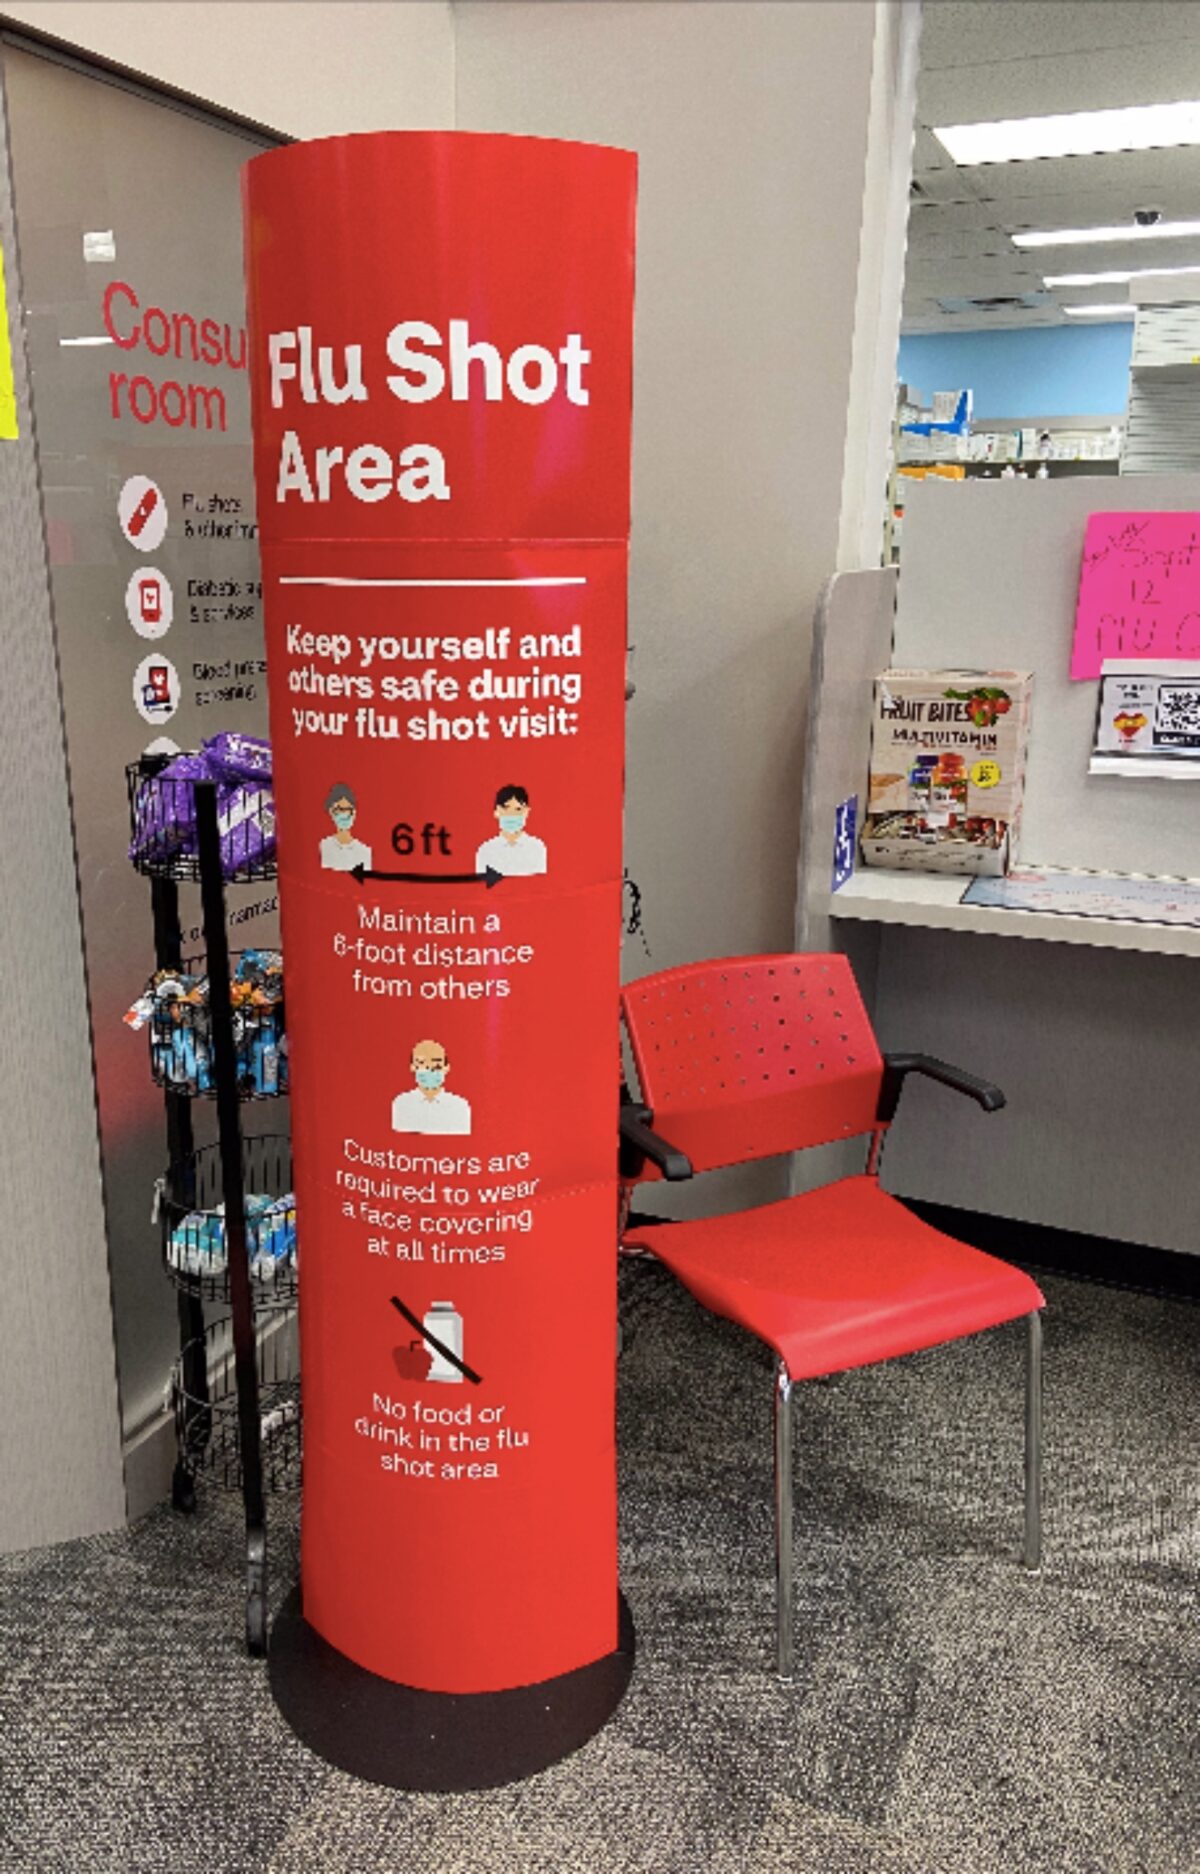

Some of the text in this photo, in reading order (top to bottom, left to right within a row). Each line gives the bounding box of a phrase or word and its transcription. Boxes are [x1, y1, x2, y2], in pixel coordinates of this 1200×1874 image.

[269, 319, 591, 408] Flu Shot
[109, 371, 226, 433] room
[277, 431, 450, 502] Area
[287, 624, 581, 670] Keep yourself and
[289, 662, 581, 704] others safe during
[293, 704, 578, 740] your flu shot visit:
[391, 823, 452, 856] 6 ft
[358, 904, 500, 934] Maintain a
[334, 933, 534, 968] 6-foot distance
[353, 969, 511, 1000] from others
[343, 1139, 531, 1175] Customers are
[336, 1169, 540, 1205] required to wear
[342, 1202, 533, 1235] a face covering
[368, 1237, 506, 1264] at all times
[373, 1393, 506, 1425] No food or
[355, 1417, 529, 1452] drink in the flu
[381, 1453, 499, 1479] shot area
